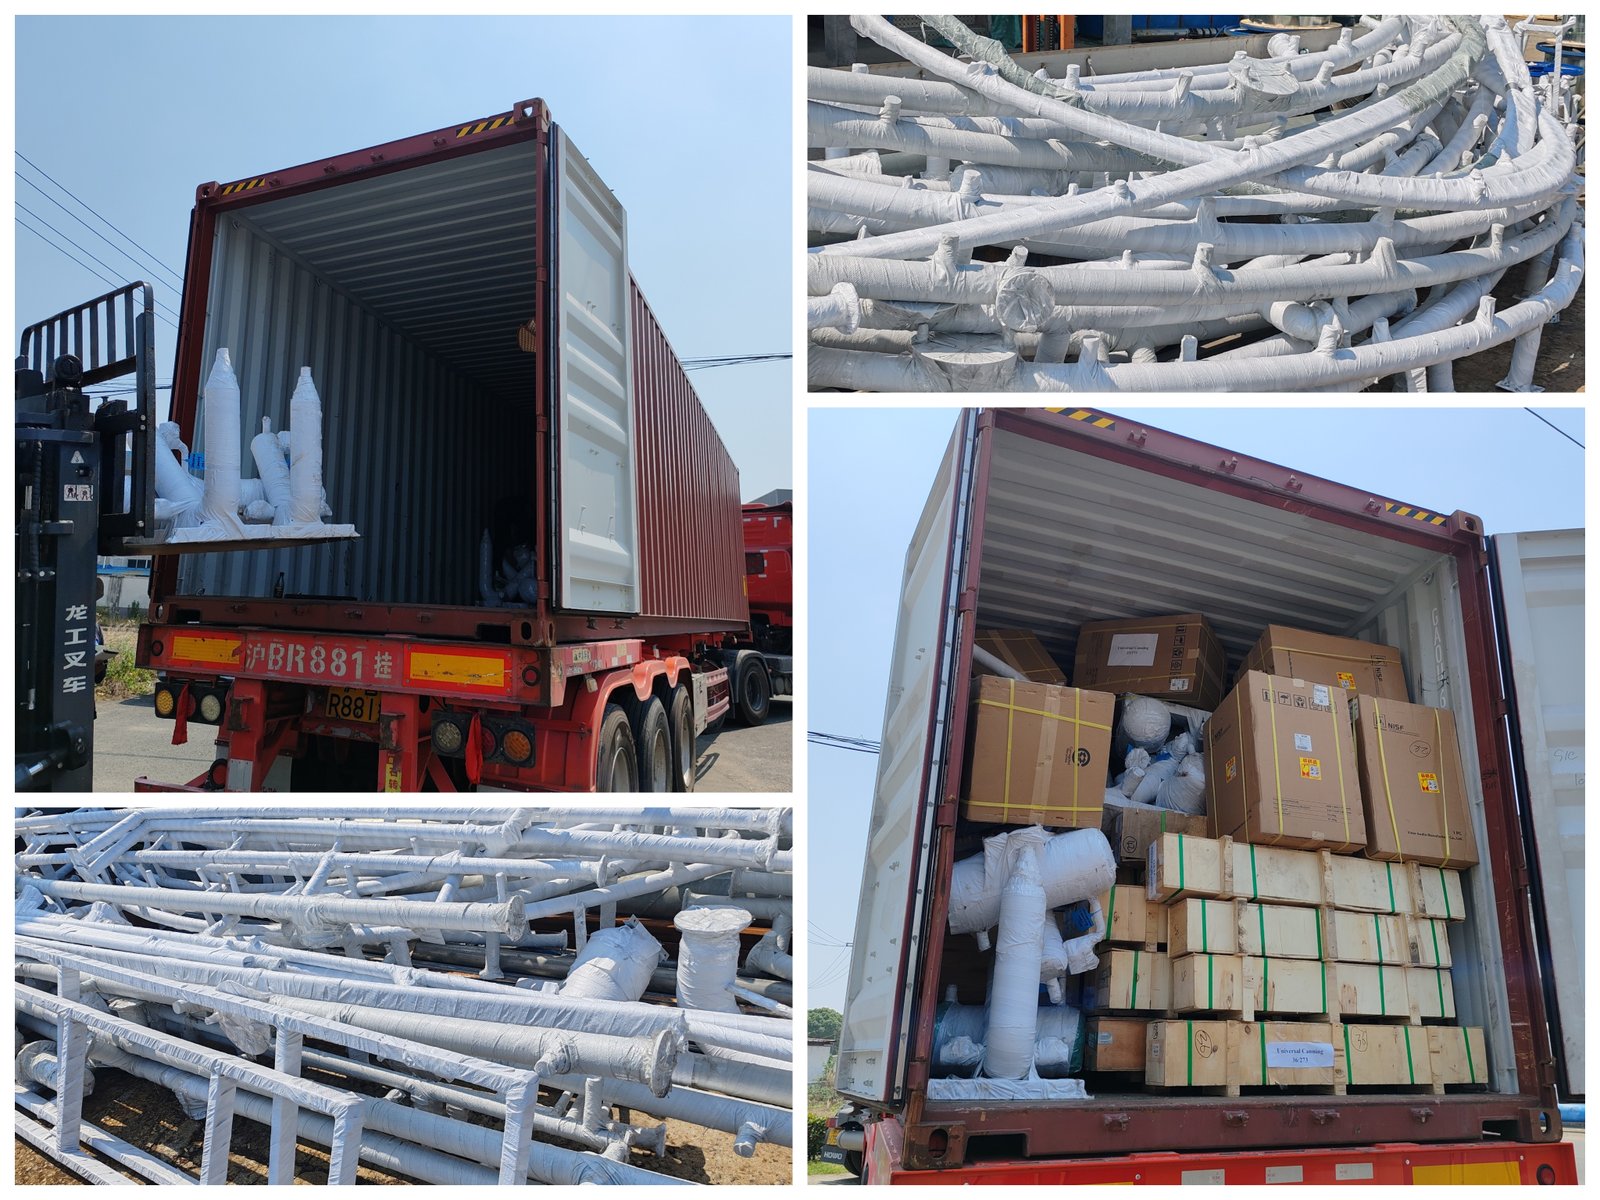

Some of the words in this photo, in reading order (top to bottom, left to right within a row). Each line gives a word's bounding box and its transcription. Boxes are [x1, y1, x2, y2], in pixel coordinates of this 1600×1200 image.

[62, 604, 88, 693] 龙工叉车
[245, 642, 364, 681] 沪BR881
[328, 693, 381, 722] R881
[823, 1151, 842, 1160] HOWO
